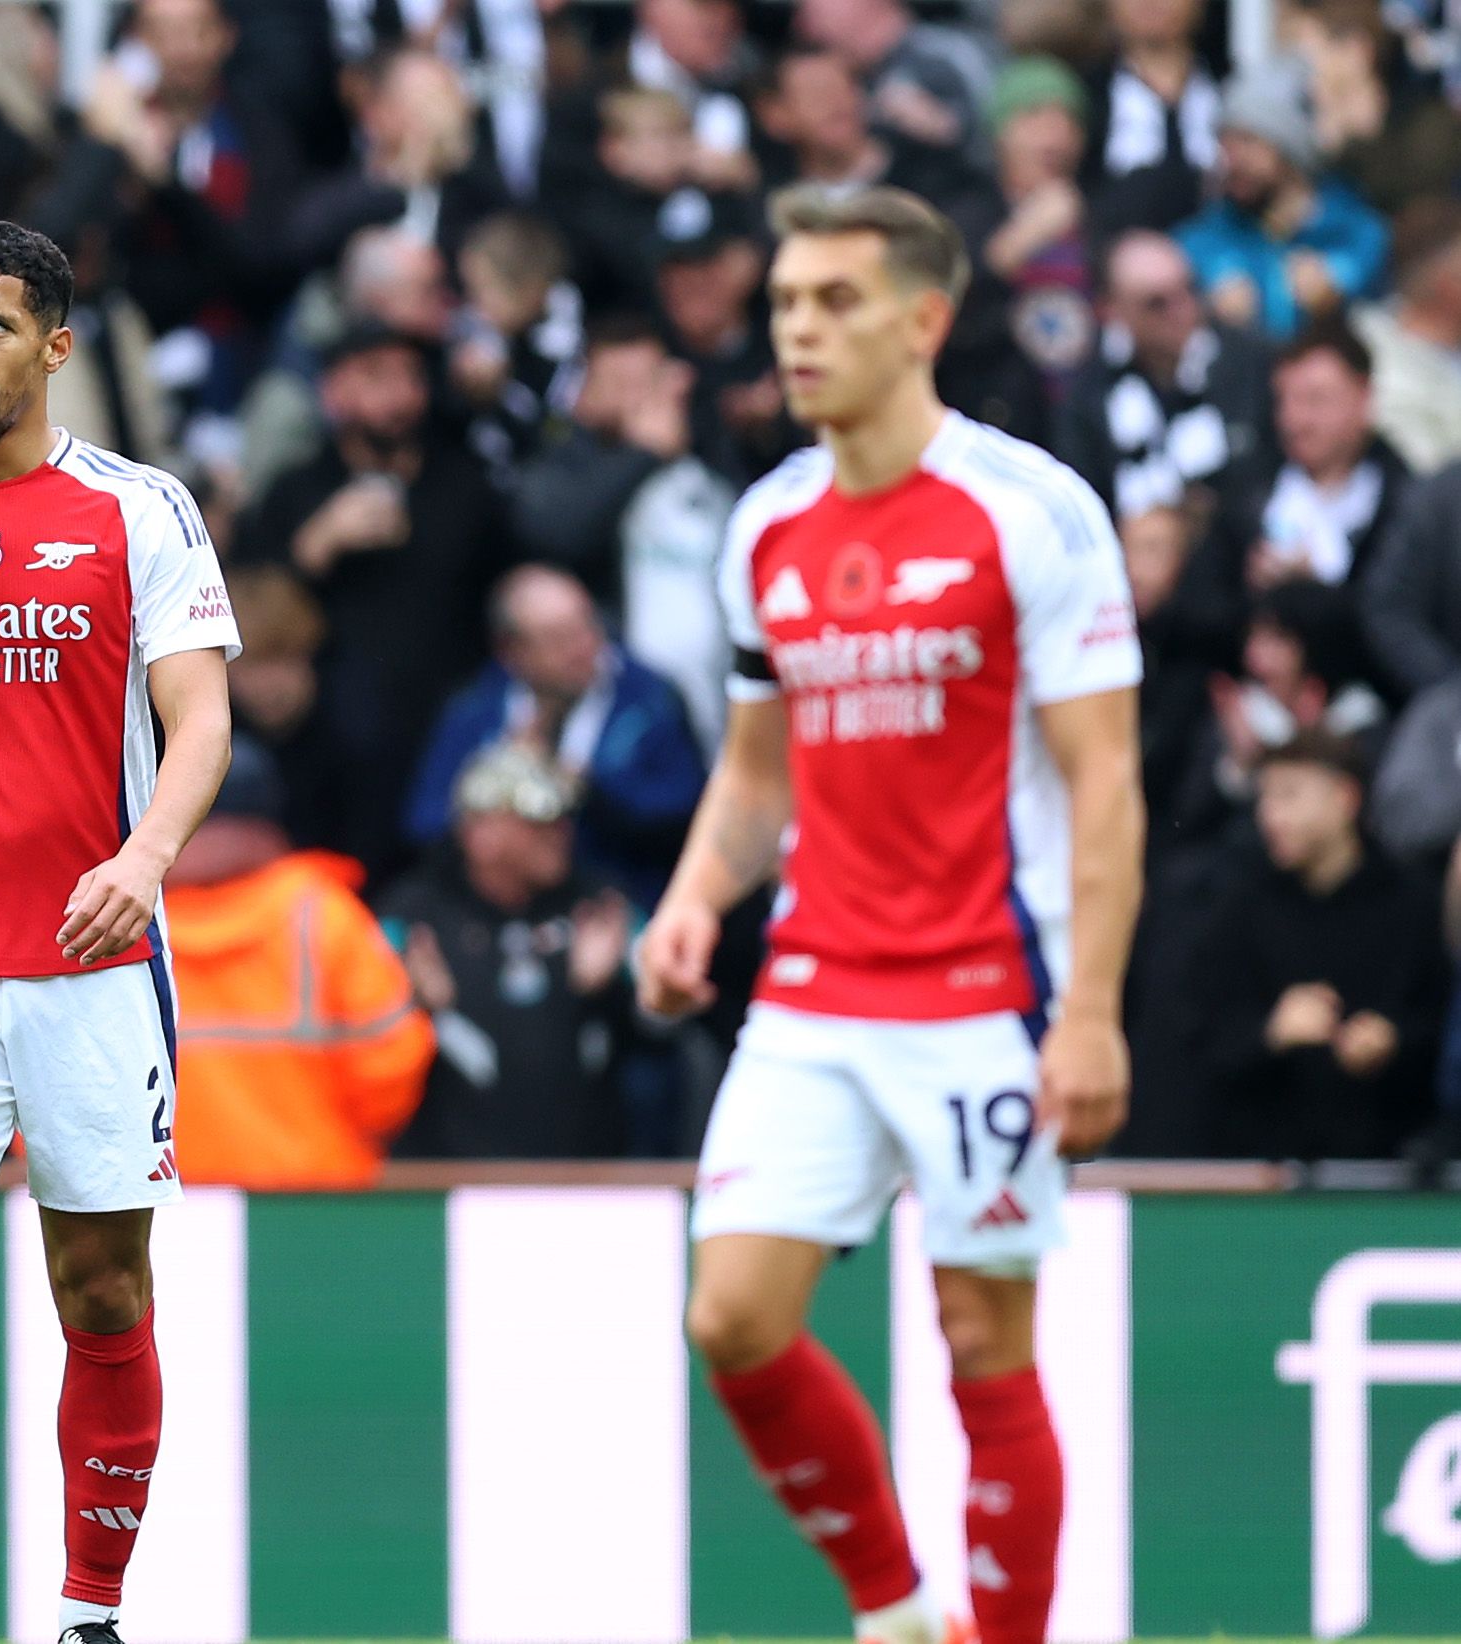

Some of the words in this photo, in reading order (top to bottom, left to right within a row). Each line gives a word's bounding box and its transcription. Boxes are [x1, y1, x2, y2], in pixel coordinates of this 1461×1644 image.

[147, 1065, 172, 1143] 2
[947, 1091, 1035, 1180] 19
[84, 1457, 153, 1481] AFC
